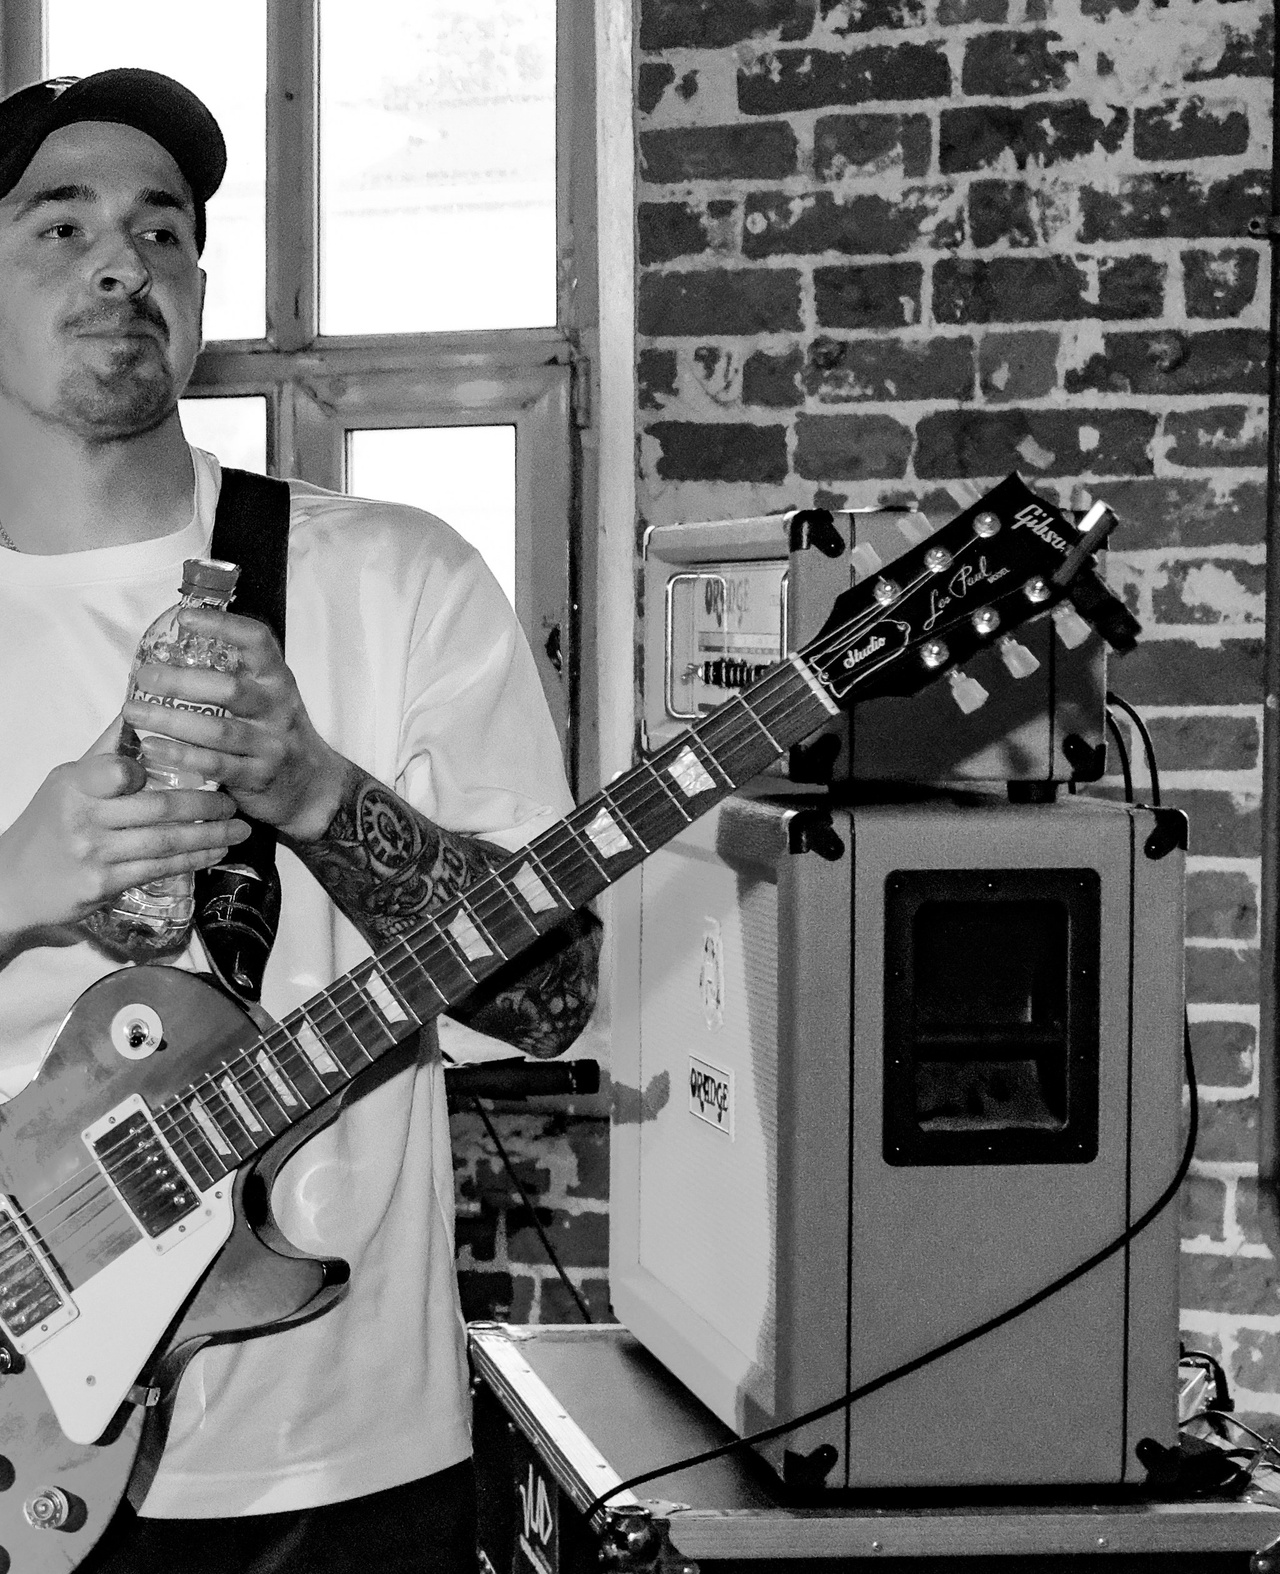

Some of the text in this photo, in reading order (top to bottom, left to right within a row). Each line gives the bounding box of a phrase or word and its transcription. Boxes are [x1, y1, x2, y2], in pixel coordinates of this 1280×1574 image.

[1011, 504, 1070, 554] Gibso
[923, 589, 952, 631] Les
[948, 555, 993, 598] Paul
[843, 636, 886, 669] Studio
[690, 1067, 728, 1123] ORANGE
